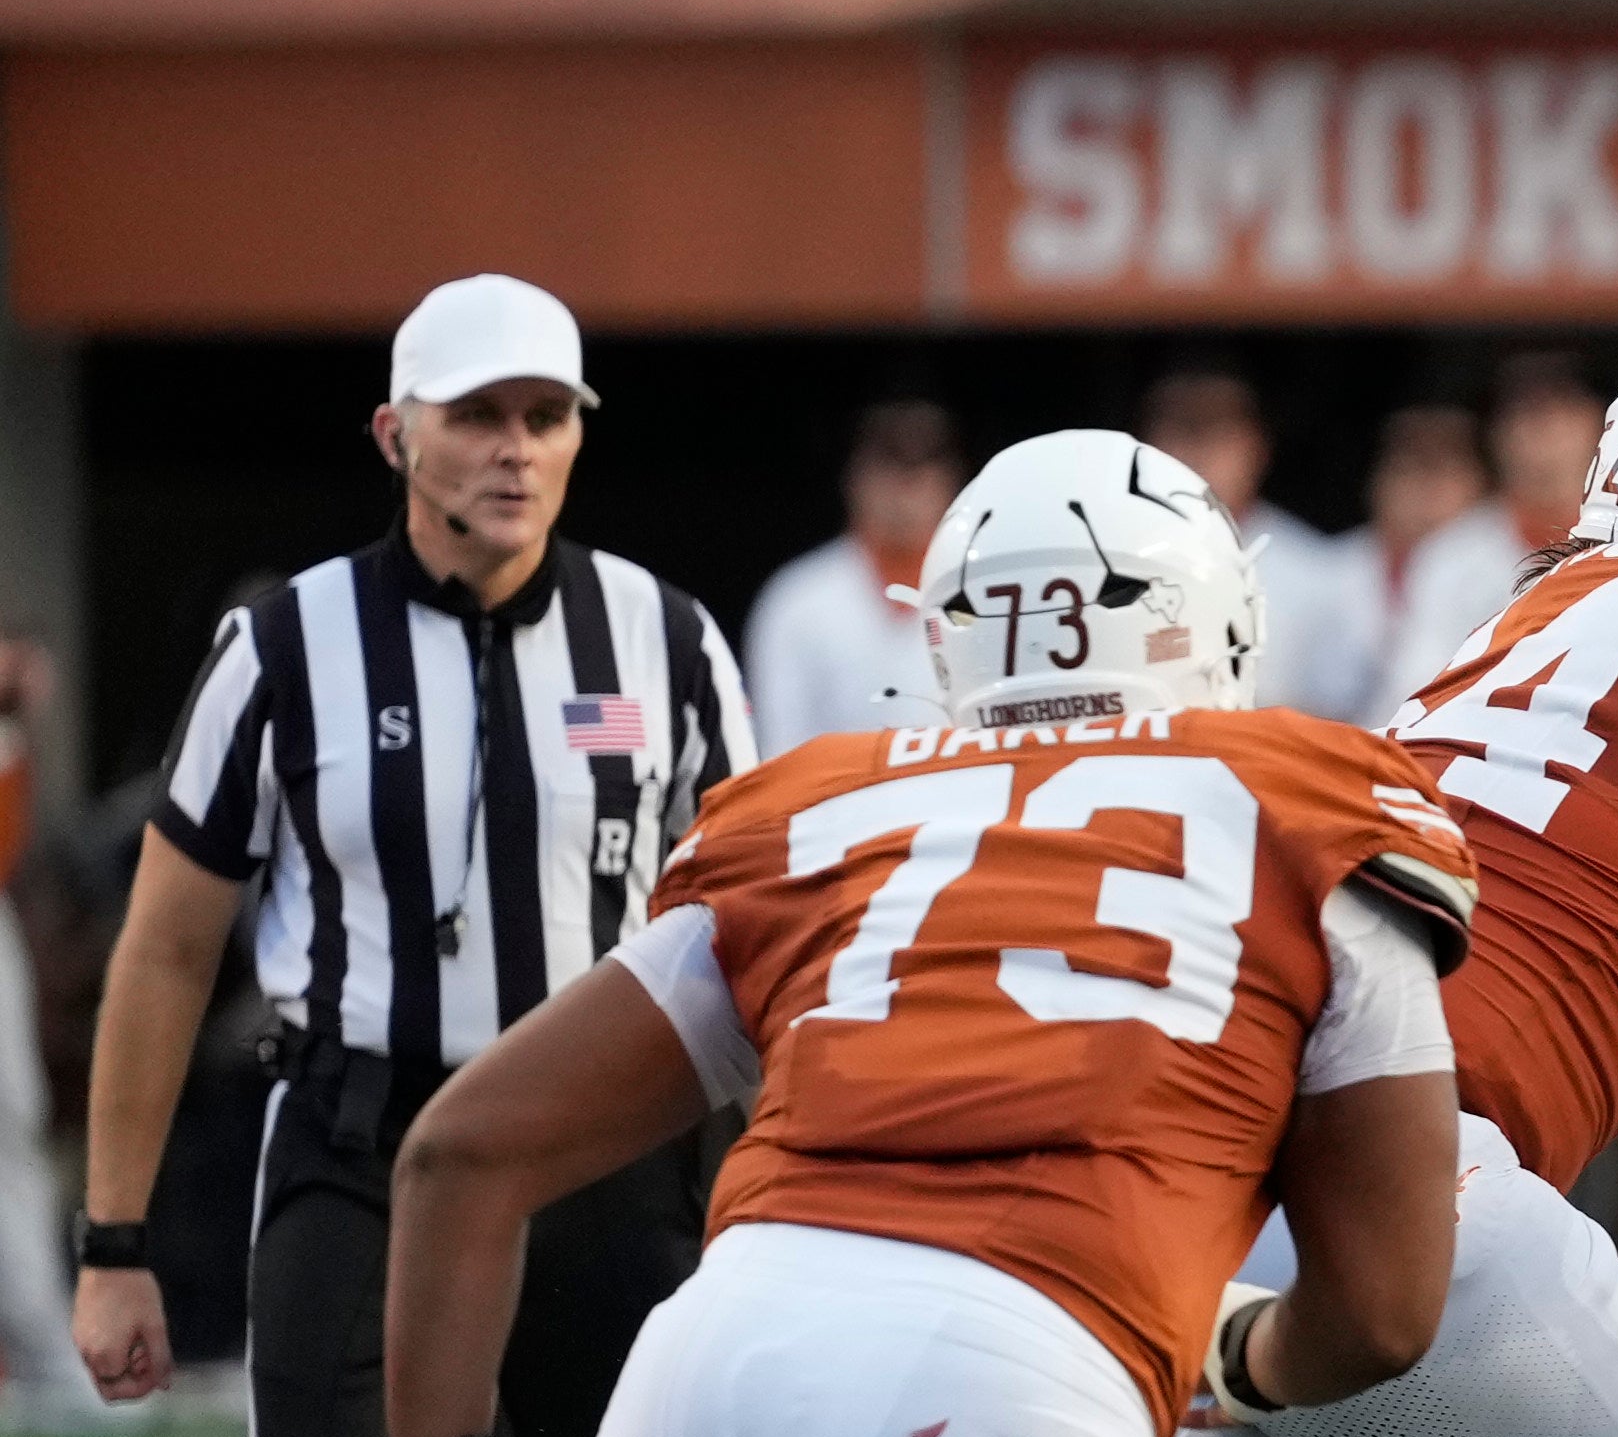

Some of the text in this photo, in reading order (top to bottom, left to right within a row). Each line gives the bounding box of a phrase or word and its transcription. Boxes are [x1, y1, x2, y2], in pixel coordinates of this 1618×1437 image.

[984, 577, 1090, 677] 73
[378, 704, 412, 751] S
[976, 691, 1126, 729] LONGHORNS
[593, 816, 631, 876] R
[783, 754, 1259, 1045] 73
